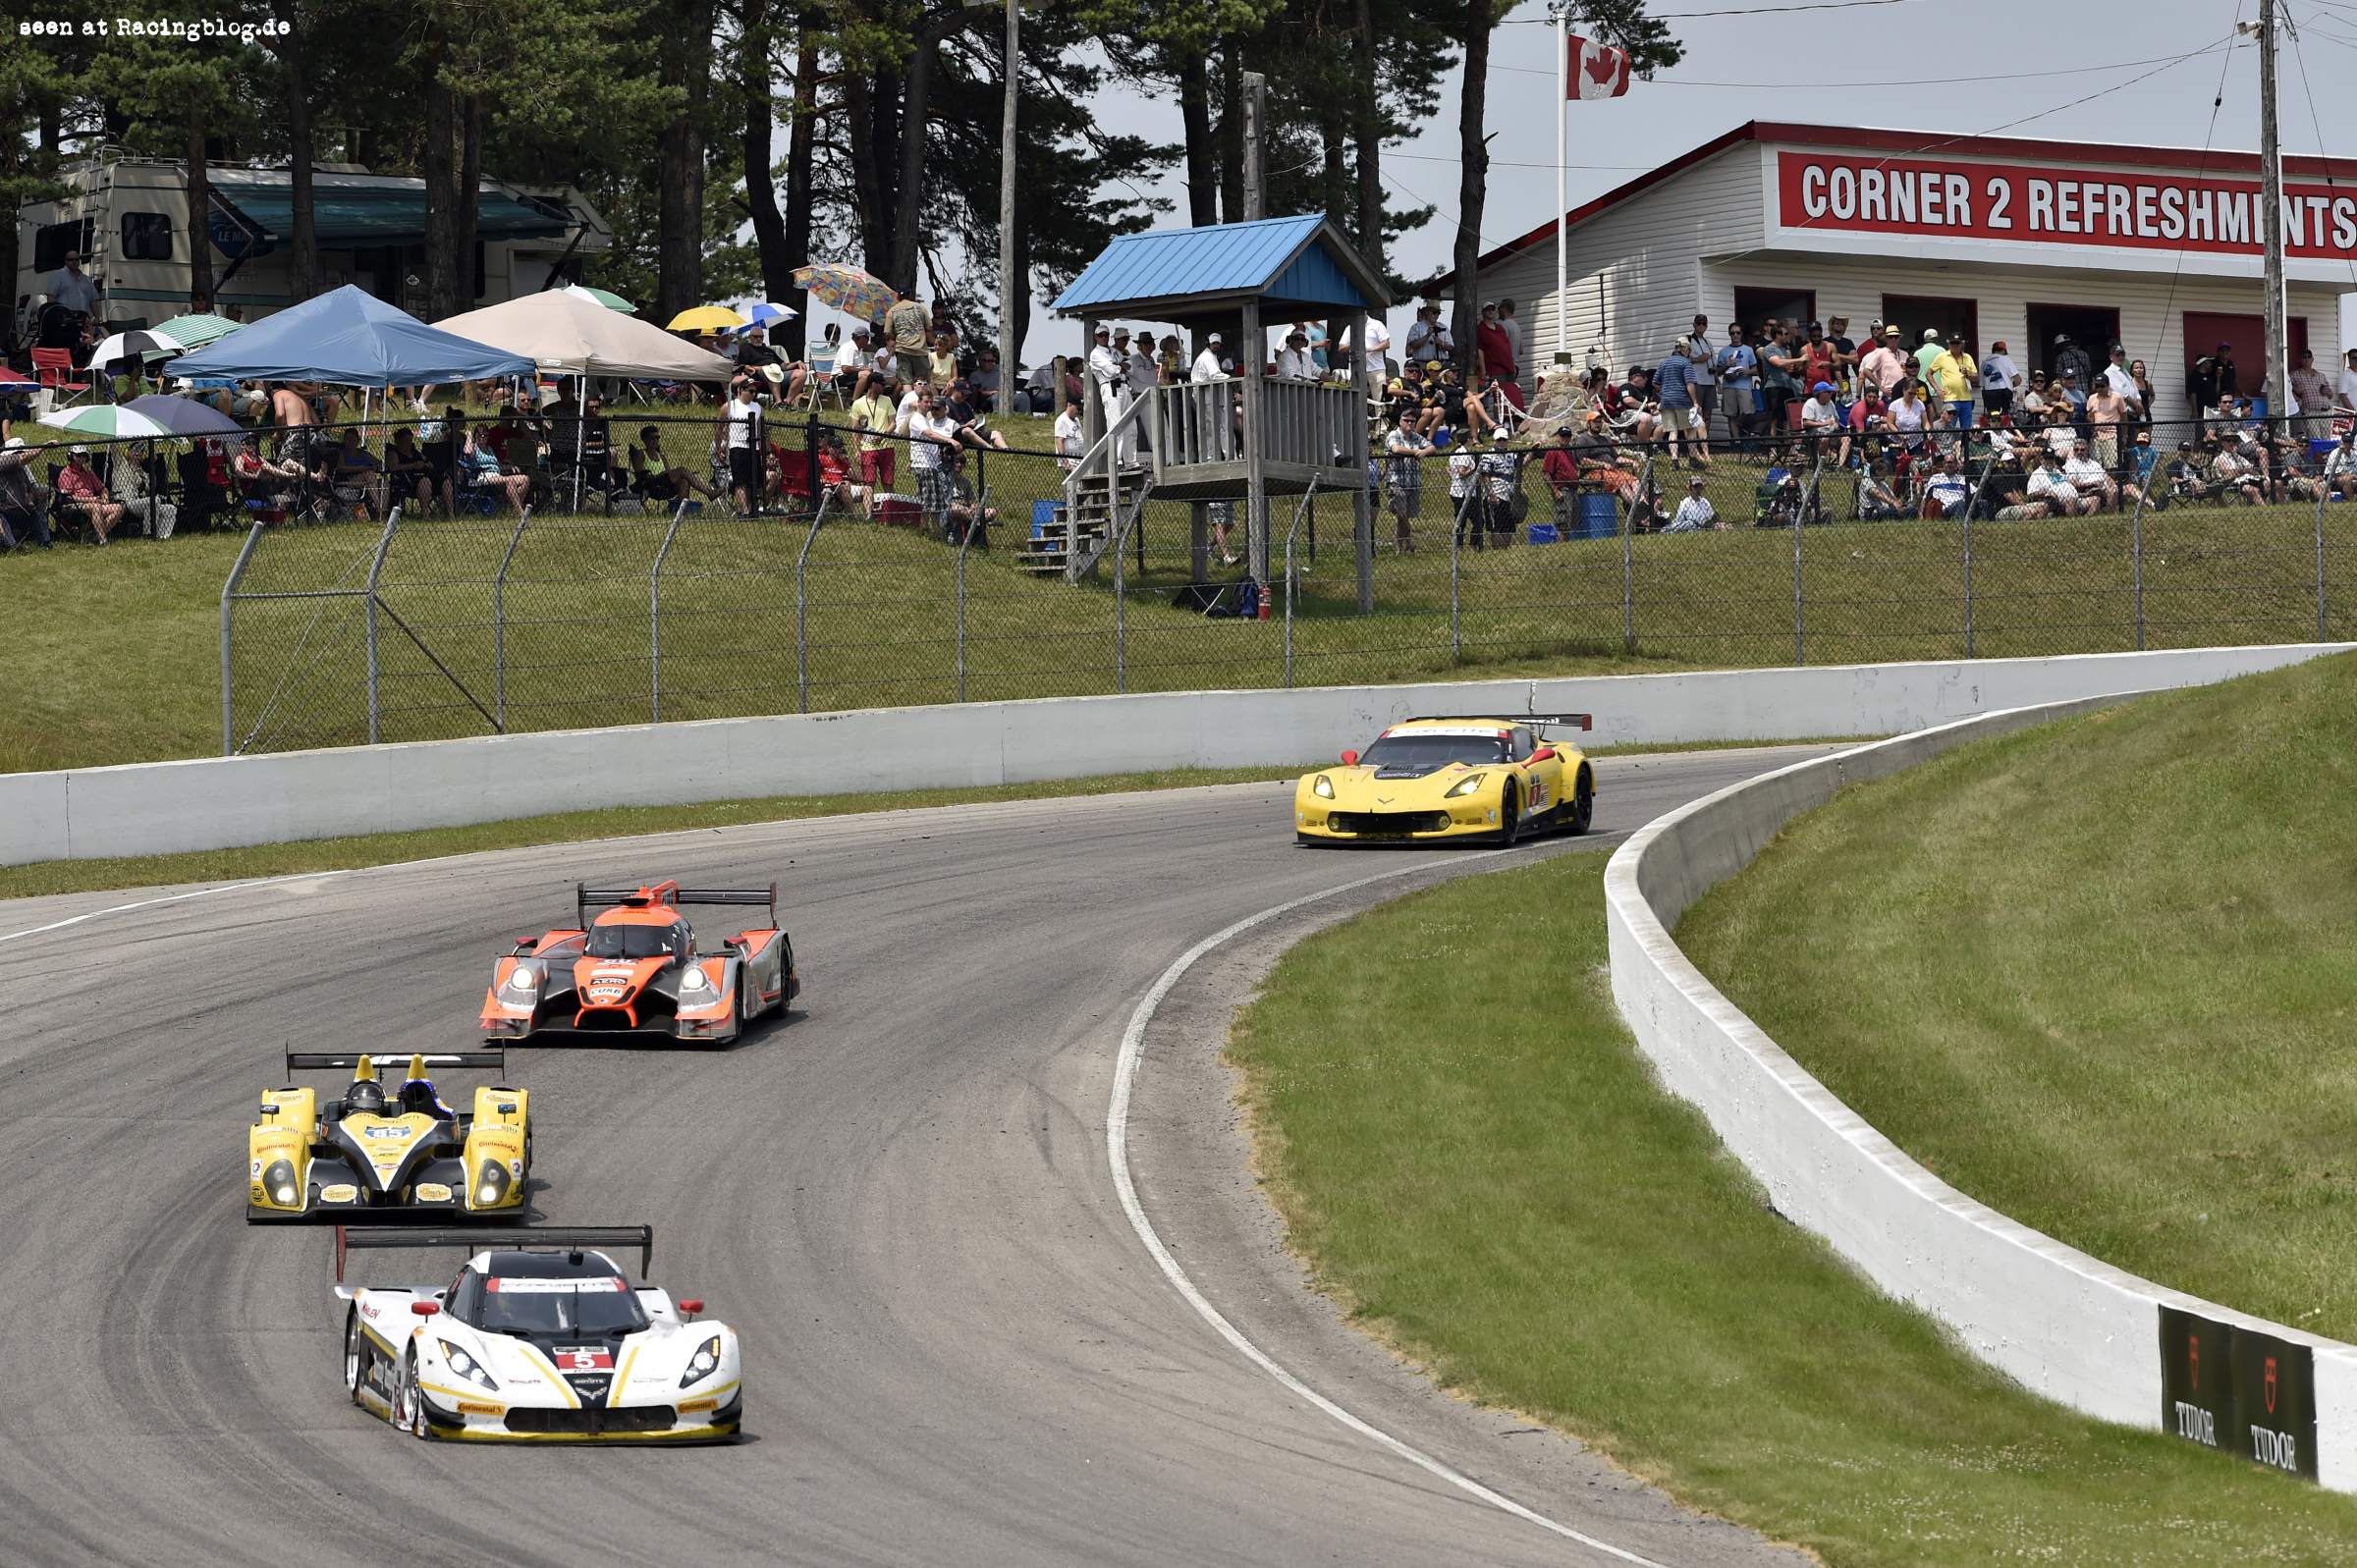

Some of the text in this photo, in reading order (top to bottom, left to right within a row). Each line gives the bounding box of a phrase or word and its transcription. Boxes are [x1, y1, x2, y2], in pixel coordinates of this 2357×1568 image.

[1802, 165, 1972, 227] CORNER
[1987, 177, 2013, 229] 2
[575, 1353, 595, 1369] 5
[2175, 1401, 2217, 1446] TUDOR
[2250, 1424, 2296, 1471] TUDOR
